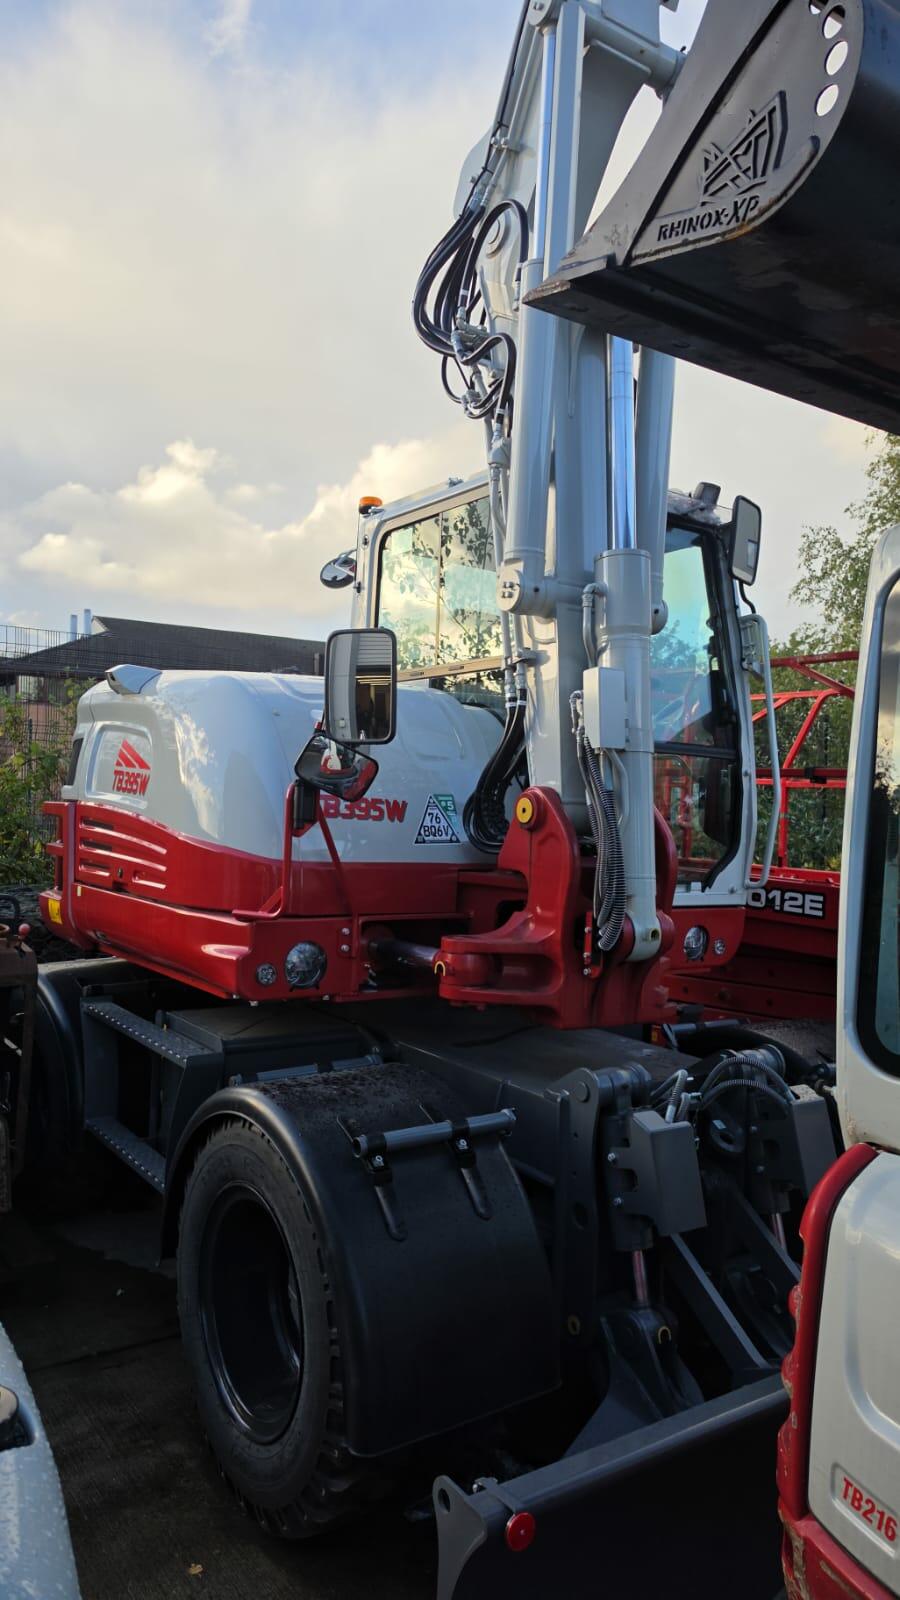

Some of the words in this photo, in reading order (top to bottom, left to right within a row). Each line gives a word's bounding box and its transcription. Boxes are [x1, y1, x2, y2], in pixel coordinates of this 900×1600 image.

[657, 195, 760, 242] RHINOX-XP
[112, 769, 151, 796] TB395W
[320, 794, 408, 823] B395W
[428, 812, 441, 824] 76
[423, 825, 449, 837] BQ6V
[843, 1476, 898, 1543] TB216
